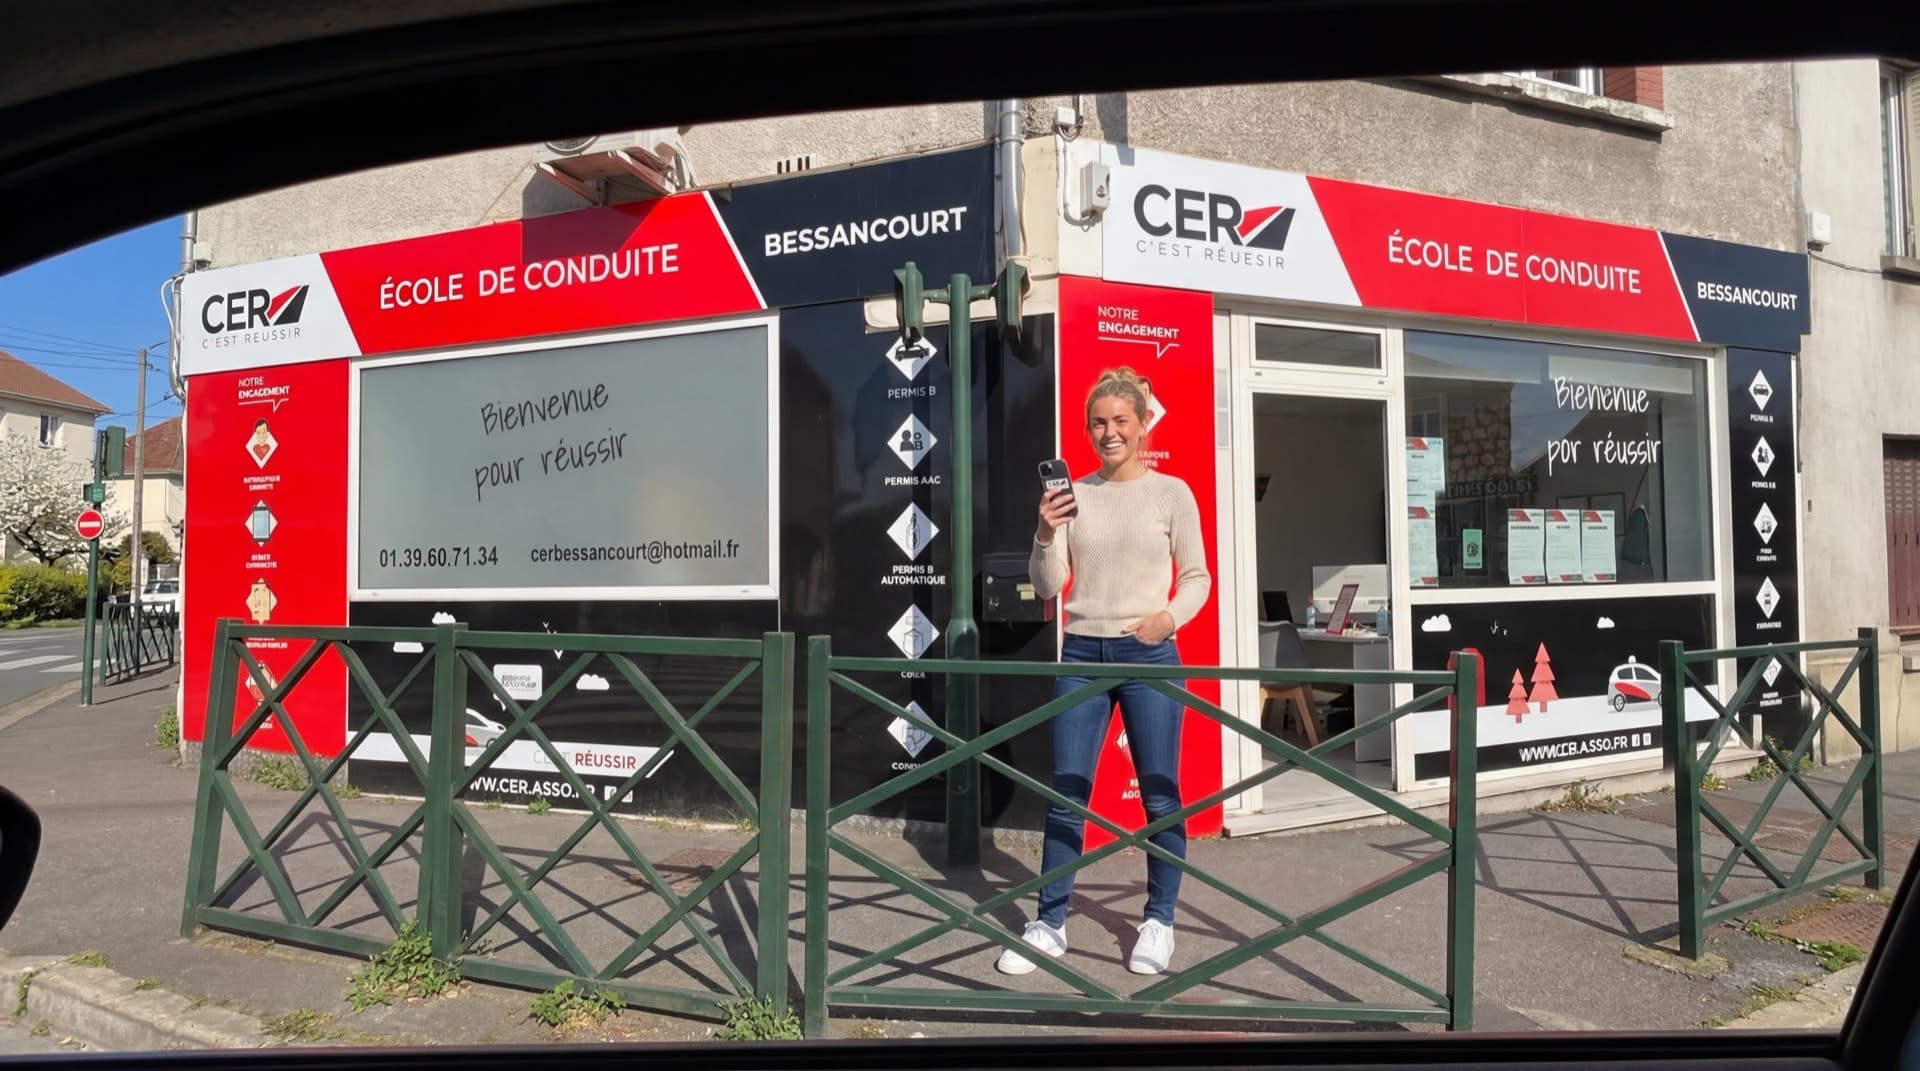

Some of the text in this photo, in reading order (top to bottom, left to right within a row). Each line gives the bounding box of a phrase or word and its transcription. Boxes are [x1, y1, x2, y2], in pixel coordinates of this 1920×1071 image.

[1134, 184, 1244, 246] CER
[765, 206, 967, 257] BESSANCOURT
[1137, 240, 1192, 258] C'EST
[1388, 229, 1641, 294] ÉCOLE DE CONDUITE
[380, 243, 679, 310] ÉCOLE DE CONDUITE
[1697, 281, 1798, 311] BESSANCOURT
[202, 288, 270, 334] CER
[1098, 306, 1139, 321] NOTRE
[202, 335, 238, 349] C'EST
[1098, 321, 1180, 339] ENGAGEMENT
[238, 376, 264, 388] NOTRE
[238, 386, 290, 399] ENGAGEMENT
[888, 386, 937, 399] PERMIS B
[481, 383, 609, 435] Bienvenue
[474, 427, 628, 502] pour réussir
[1547, 431, 1661, 477] por réussir
[885, 477, 919, 486] PERMIS
[379, 539, 740, 568] 01.39.60.71.34 cerbessancourt@hotmail.fr
[575, 750, 636, 770] RÉUSSIR
